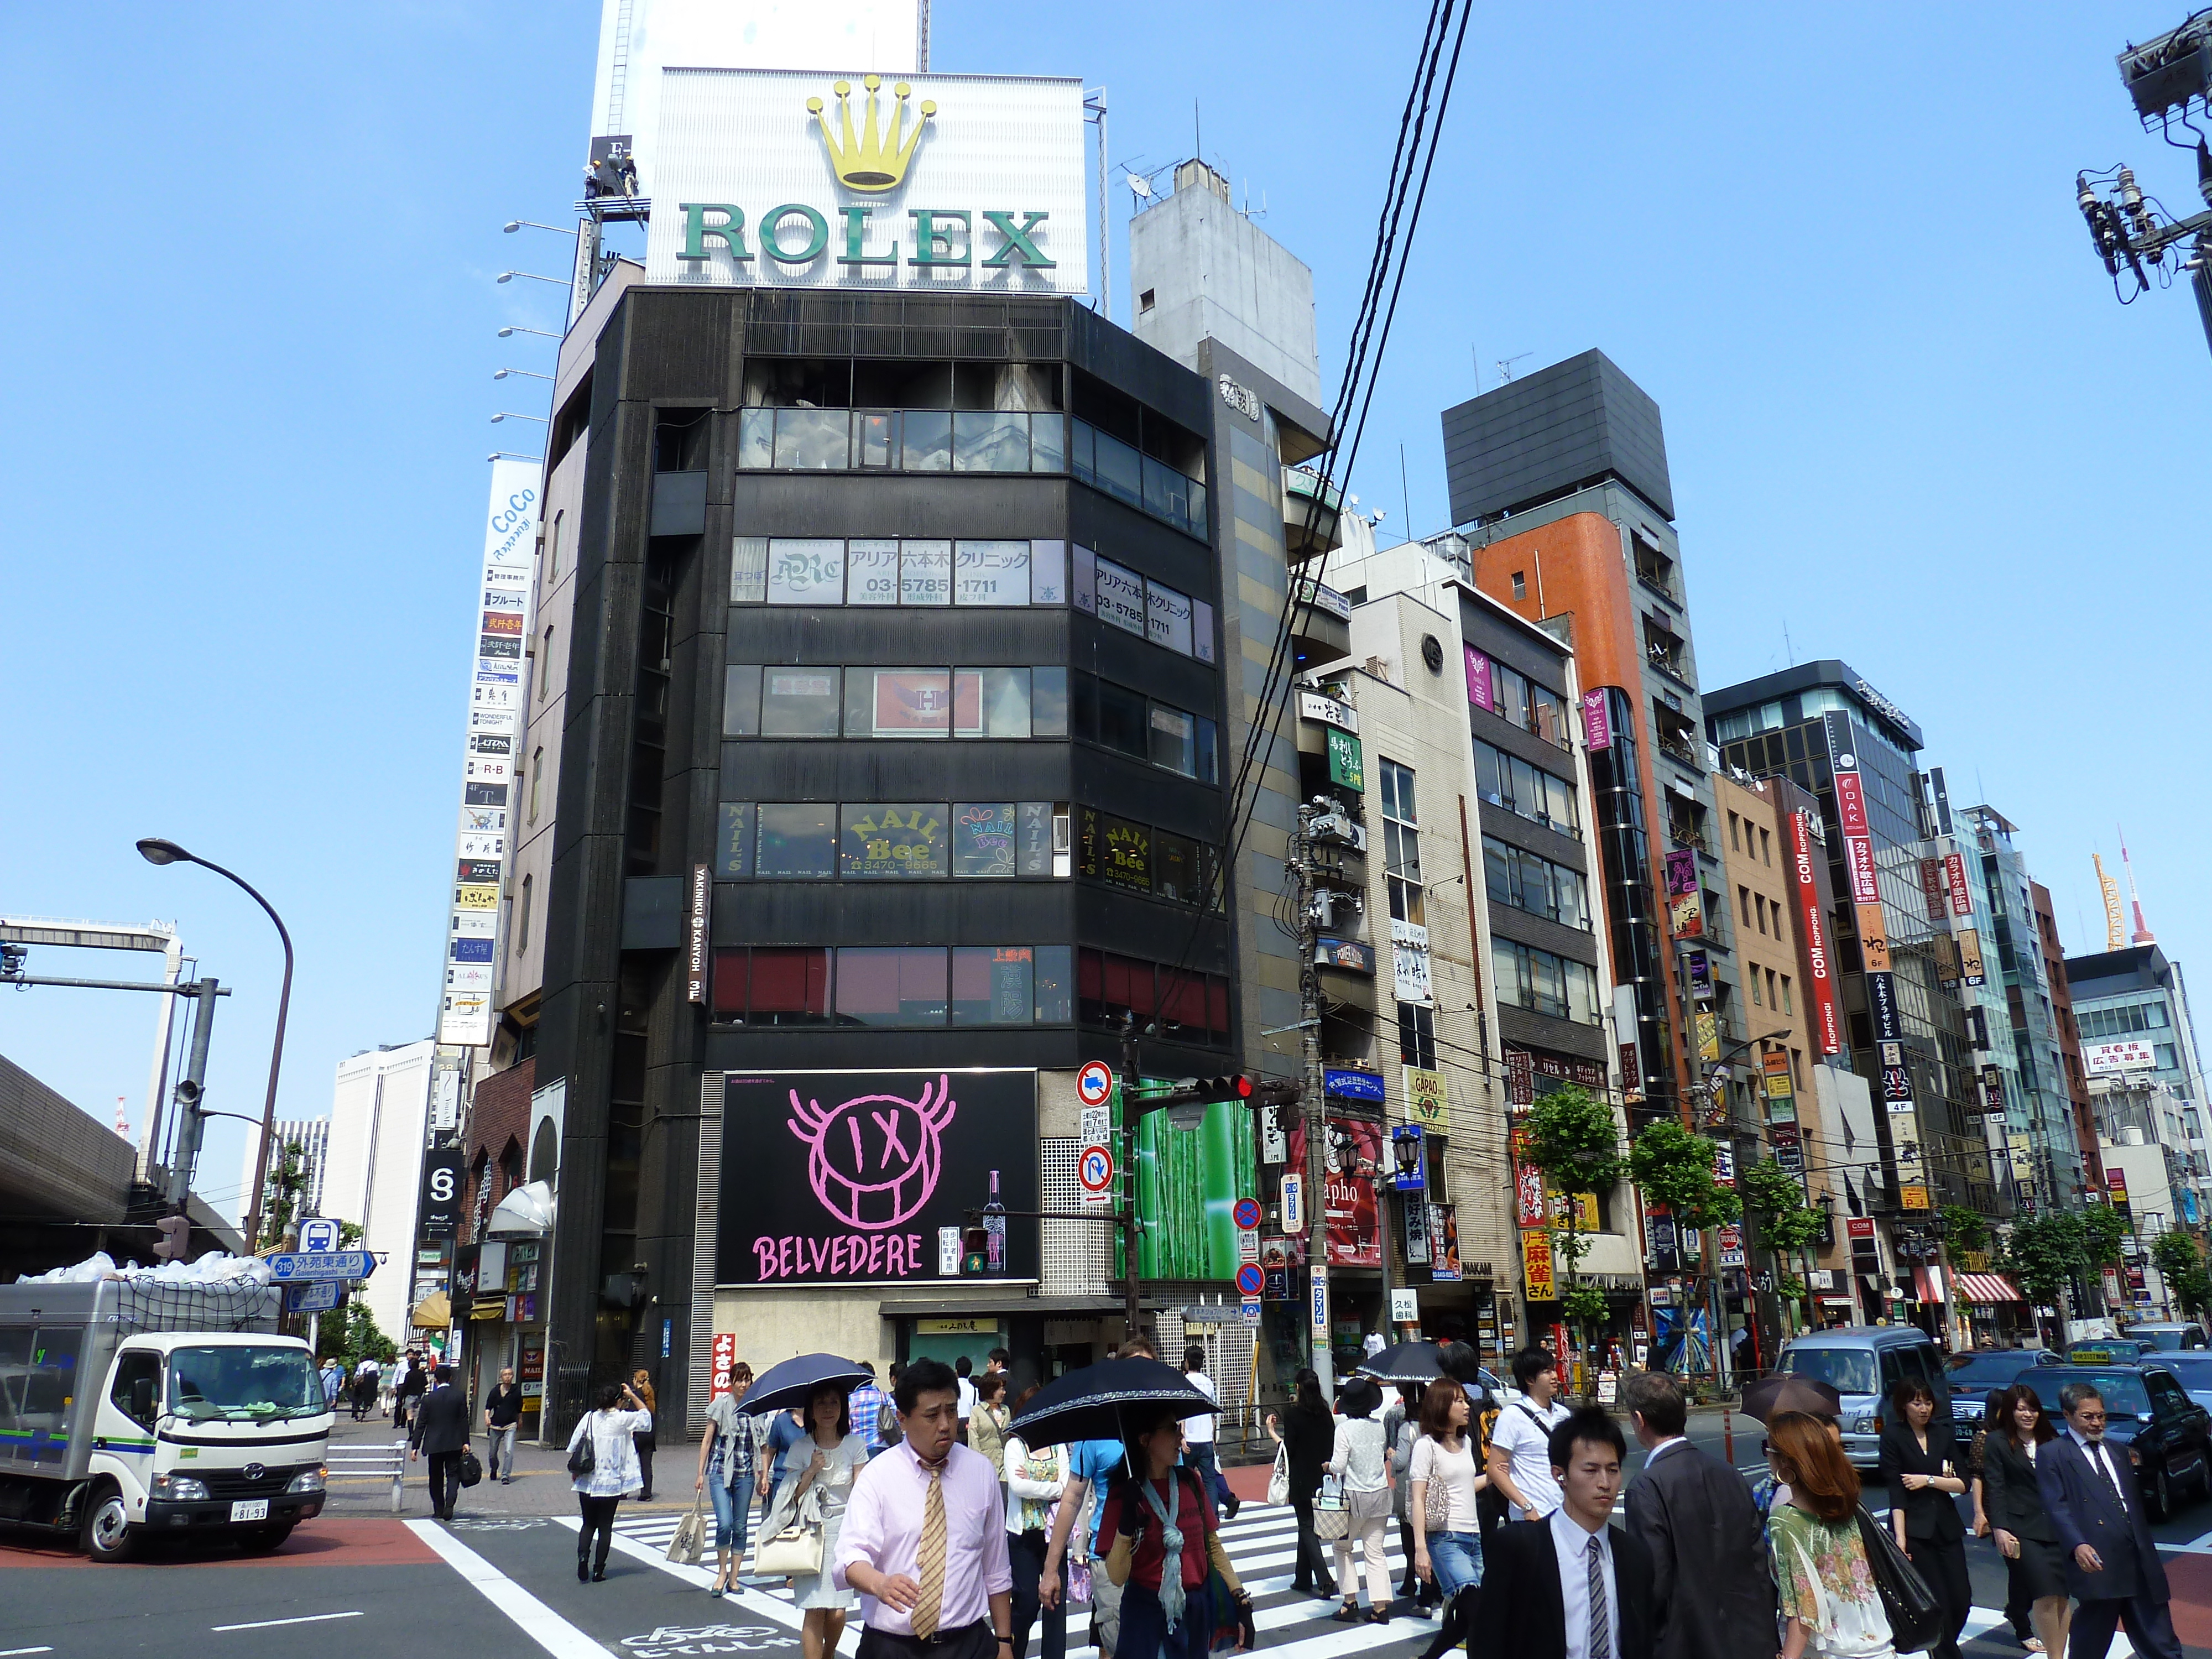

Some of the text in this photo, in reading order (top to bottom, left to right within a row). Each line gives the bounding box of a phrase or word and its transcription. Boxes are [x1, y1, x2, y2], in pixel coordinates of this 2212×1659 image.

[676, 202, 1057, 269] ROLEX
[492, 489, 535, 533] CoCo
[493, 516, 530, 560] Roppongi
[850, 551, 1029, 568] アリア六本木クリニック
[866, 578, 997, 592] 03-5785-1711
[492, 595, 523, 607] ブルート
[860, 592, 895, 601] 美容外科
[906, 593, 942, 601] 形成外科
[484, 764, 503, 774] R-B
[1845, 791, 1859, 822] OAK
[851, 809, 939, 842] NAIL
[970, 821, 1013, 834] NAIL
[1795, 813, 1808, 853] ROPPONGI
[728, 806, 744, 871] NAIL'S
[1026, 806, 1042, 871] NAIL'S
[1106, 827, 1149, 855] NAIL
[866, 841, 930, 860] Bee
[864, 860, 937, 869] 3470-9665
[1114, 851, 1145, 870] Bee
[1796, 853, 1812, 884] COM
[1855, 841, 1875, 895] カラオケ歌広場
[1948, 856, 1968, 912] カラオケ歌広場
[689, 869, 705, 1000] YAKINIKU KANYOH 3F
[1809, 905, 1822, 947] ROPPONGI
[462, 943, 488, 955] たんす屋
[1810, 946, 1826, 979] COM
[1823, 1003, 1838, 1047] ROPPONGI
[2100, 1042, 2140, 1054] 貸看板
[2093, 1052, 2150, 1065] 広告募集
[1543, 1062, 1559, 1075] リセル
[1577, 1065, 1595, 1075] ボディケア
[1416, 1077, 1437, 1095] GAPAO
[1324, 1178, 1358, 1207] apho
[1906, 1199, 1913, 1208] P
[1407, 1191, 1423, 1241] お好み焼
[1522, 1230, 1549, 1244] リーチ
[276, 1255, 359, 1272] 319 外苑東通り
[753, 1234, 922, 1281] BELVEDERE
[946, 1255, 953, 1271] 専用
[1526, 1245, 1551, 1283] 麻雀
[296, 1268, 338, 1276] Gaienhigashi
[1528, 1284, 1553, 1297] さん
[1315, 1288, 1323, 1324] タマリヤ
[1395, 1300, 1412, 1309] 久松
[1395, 1311, 1412, 1319] 歯科
[239, 1508, 265, 1519] 81-93
